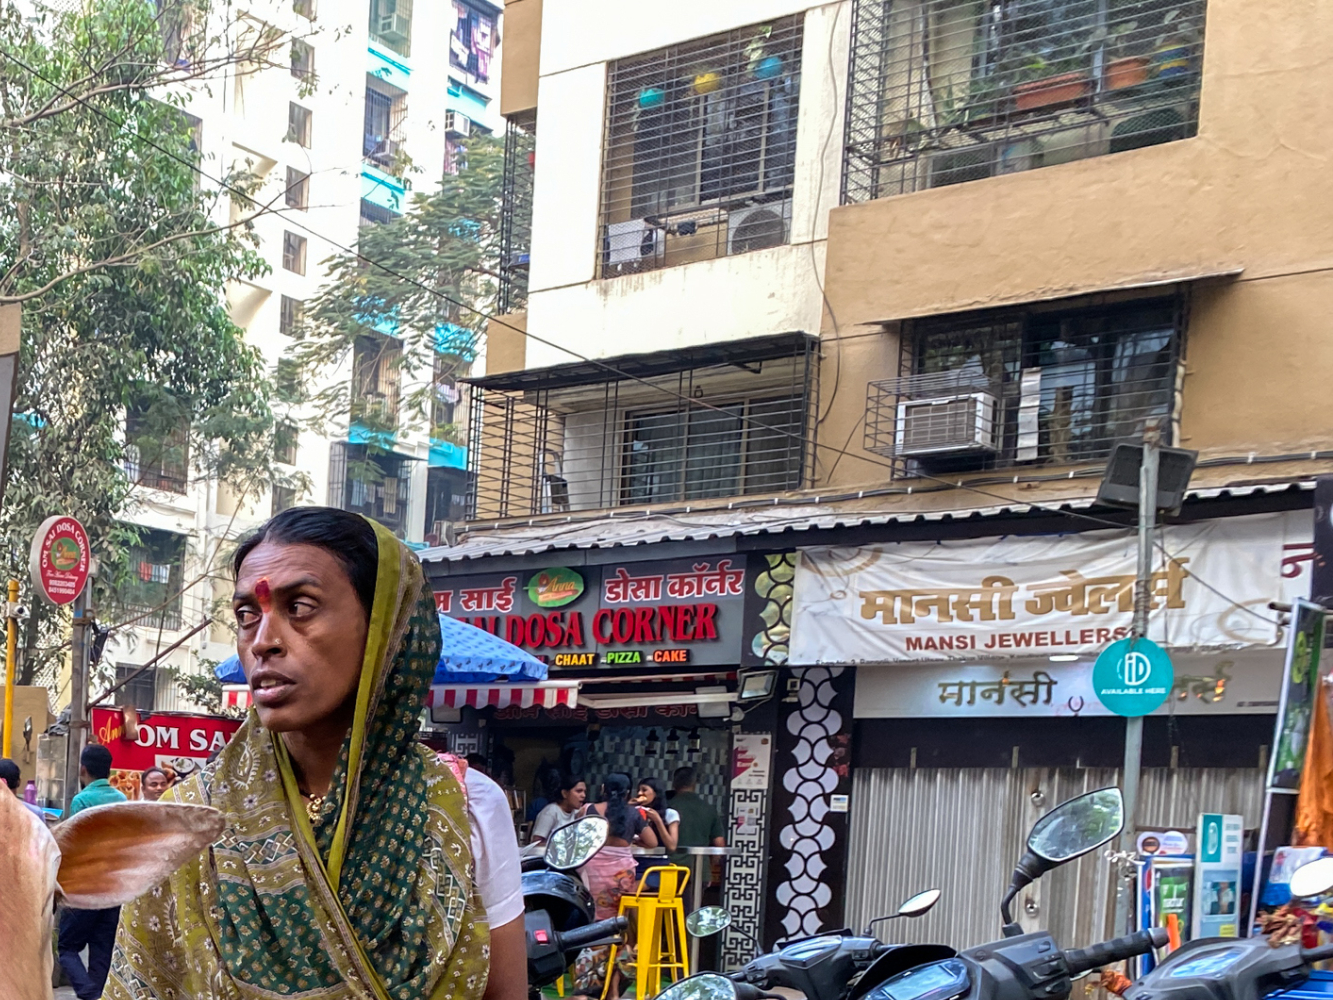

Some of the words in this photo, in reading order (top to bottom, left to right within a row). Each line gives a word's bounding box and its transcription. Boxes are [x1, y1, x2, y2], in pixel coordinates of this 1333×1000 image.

[46, 530, 56, 548] SAI
[56, 522, 75, 534] DOSA
[74, 530, 86, 573] CORNER
[432, 589, 454, 614] म
[459, 576, 518, 613] साई
[604, 567, 665, 604] डोसा
[666, 559, 746, 599] कॉर्नर
[859, 575, 1019, 625] मानसी
[505, 611, 584, 649] DOSA
[593, 603, 719, 645] CORNER
[905, 634, 976, 652] MANSI
[983, 626, 1129, 650] JEWELLERS
[555, 653, 595, 667] CHAAT
[606, 651, 641, 664] PIZZA
[653, 650, 687, 662] CAKE
[1100, 687, 1144, 695] AVAILABLE
[1144, 687, 1167, 695] HERE
[135, 723, 180, 750] OM
[189, 728, 236, 752] SA
